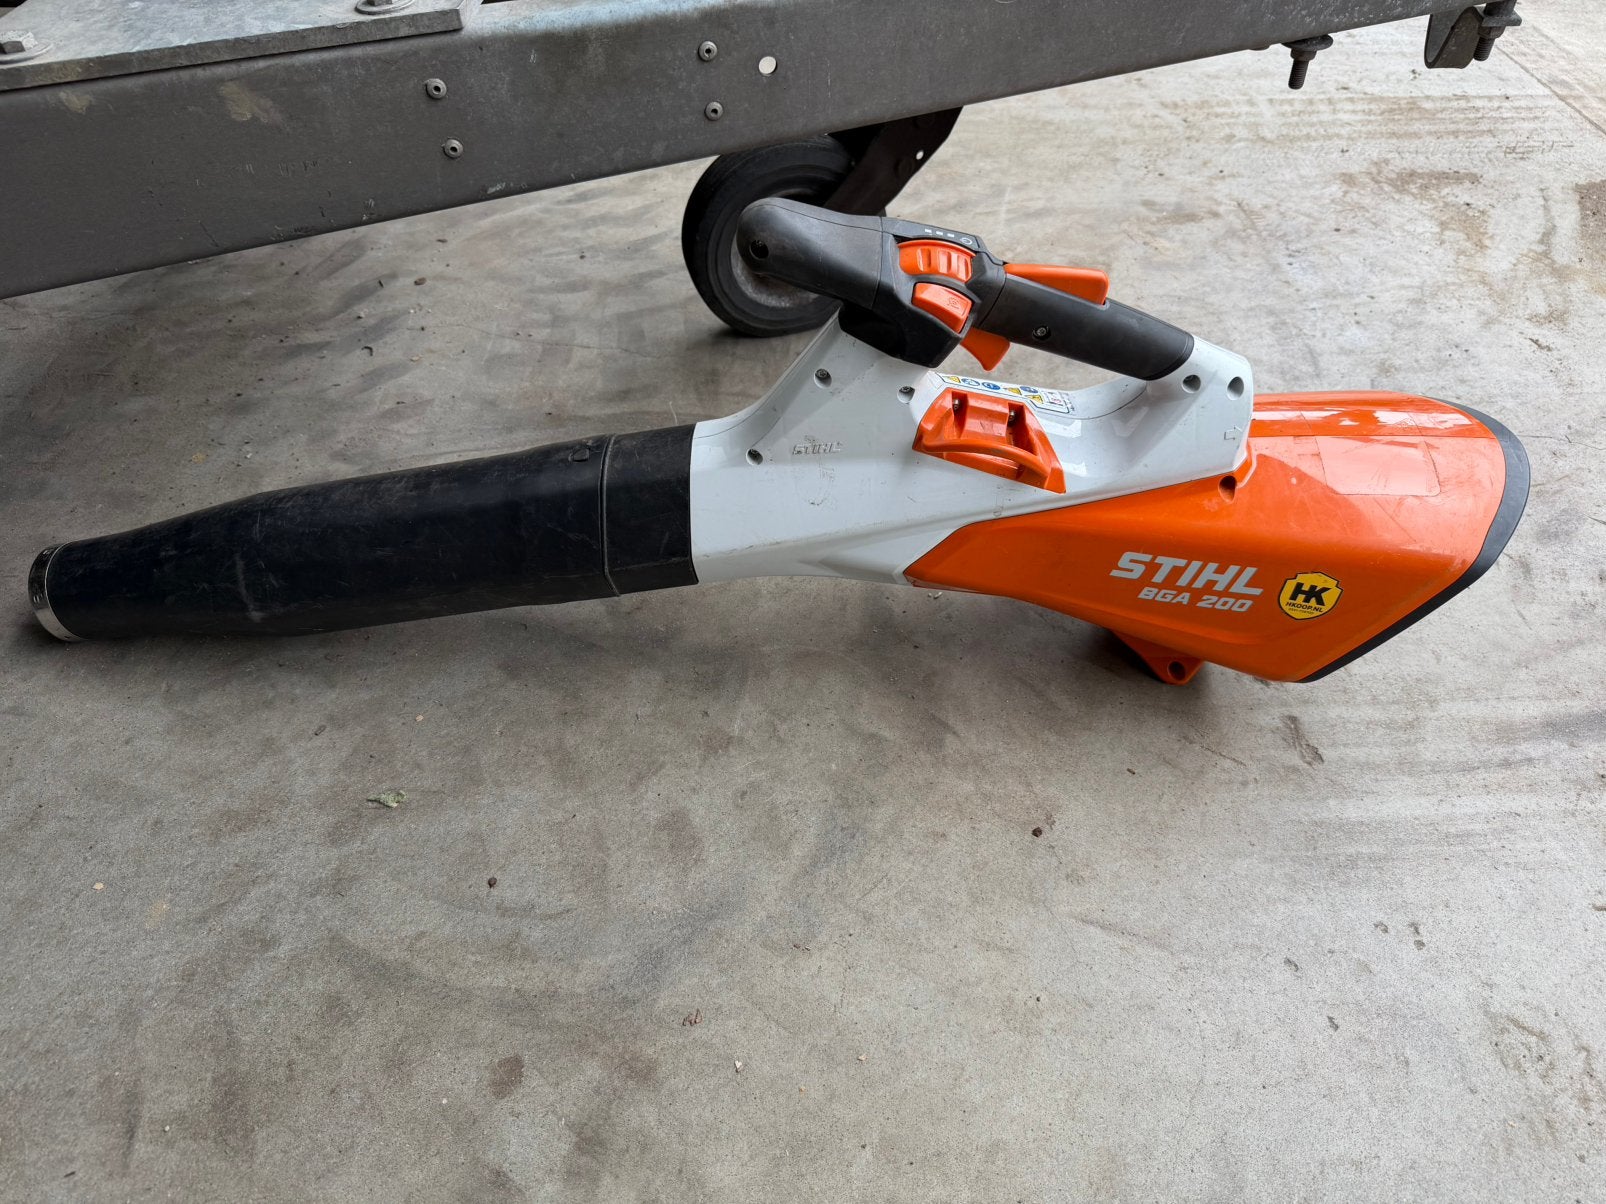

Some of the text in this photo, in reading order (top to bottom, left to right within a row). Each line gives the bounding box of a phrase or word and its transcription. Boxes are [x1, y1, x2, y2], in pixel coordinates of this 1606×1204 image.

[1110, 552, 1263, 595] STIHL
[1138, 587, 1253, 612] BGA 200
[1289, 582, 1332, 606] HK
[1285, 602, 1323, 612] HKOOP.NL
